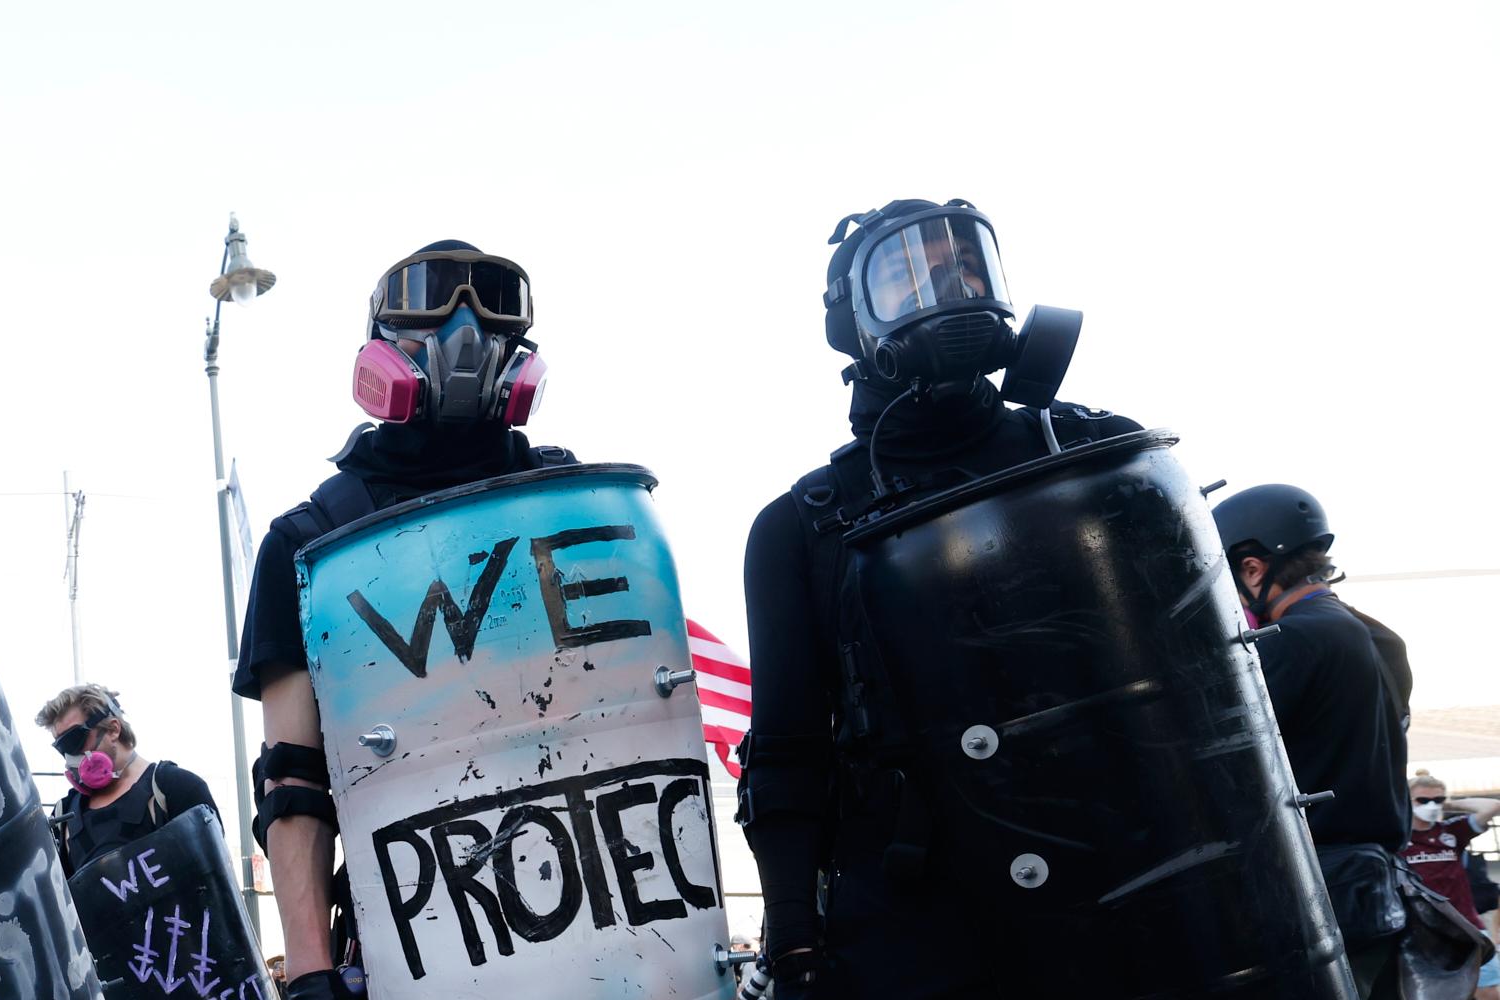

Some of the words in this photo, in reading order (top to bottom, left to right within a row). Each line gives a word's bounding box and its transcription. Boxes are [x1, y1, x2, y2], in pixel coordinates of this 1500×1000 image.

[346, 524, 653, 679] WE
[101, 848, 170, 902] WE
[372, 756, 725, 982] PROTECT
